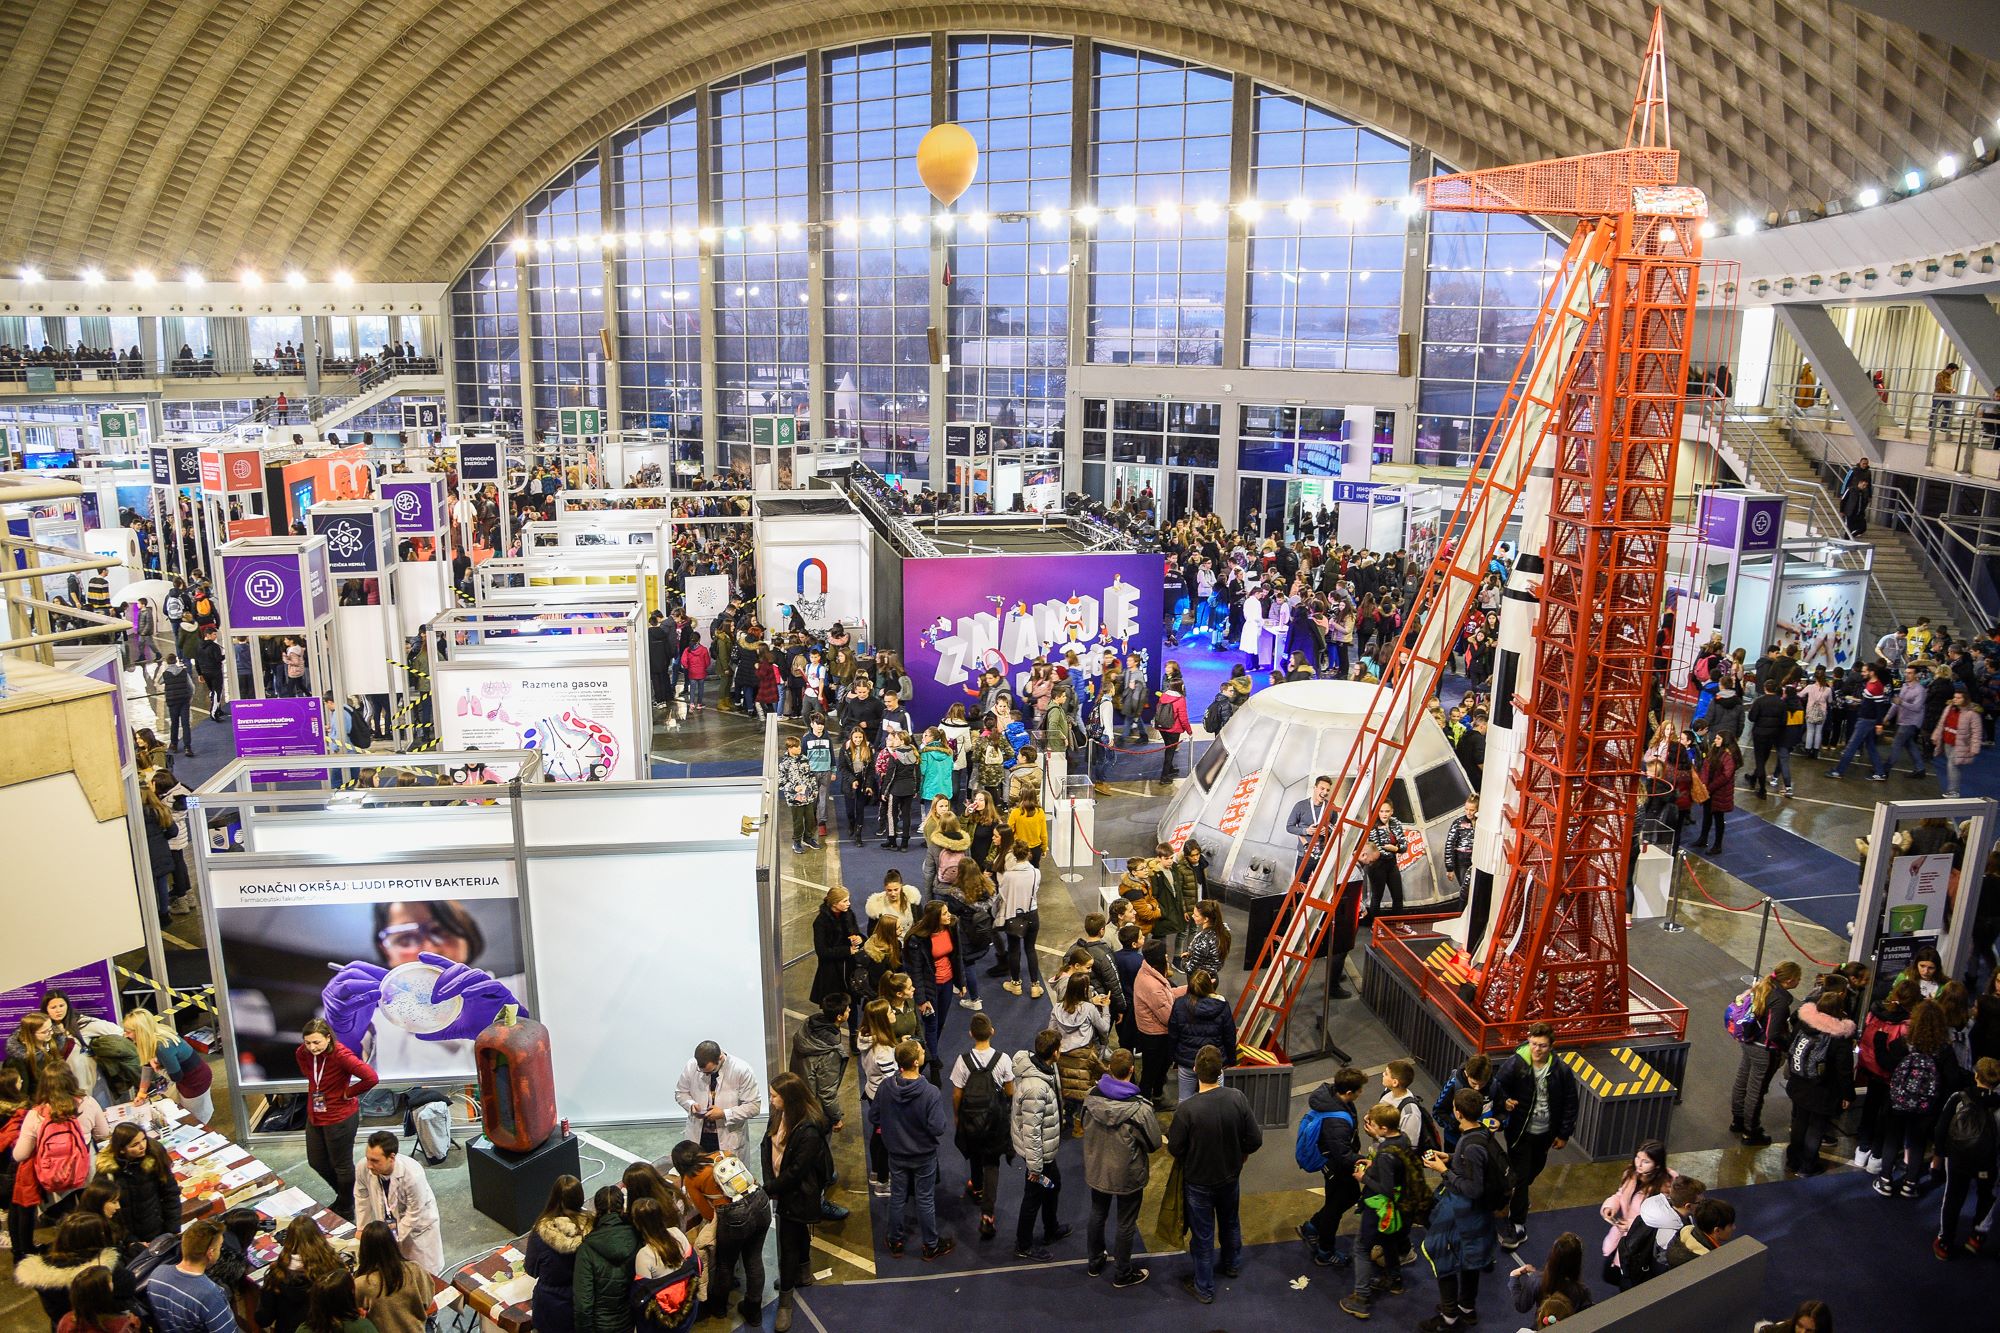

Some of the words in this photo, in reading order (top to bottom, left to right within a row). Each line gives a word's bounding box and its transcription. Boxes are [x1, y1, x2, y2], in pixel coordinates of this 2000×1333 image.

[522, 680, 569, 689] Razmena
[571, 681, 608, 690] gasova
[239, 881, 297, 895] KONAČNI
[352, 880, 386, 890] LJUDI
[388, 878, 433, 889] PROTIV
[435, 876, 500, 888] BAKTERIJA
[1884, 945, 1911, 953] PLASTIKA
[1793, 1037, 1809, 1072] adidas
